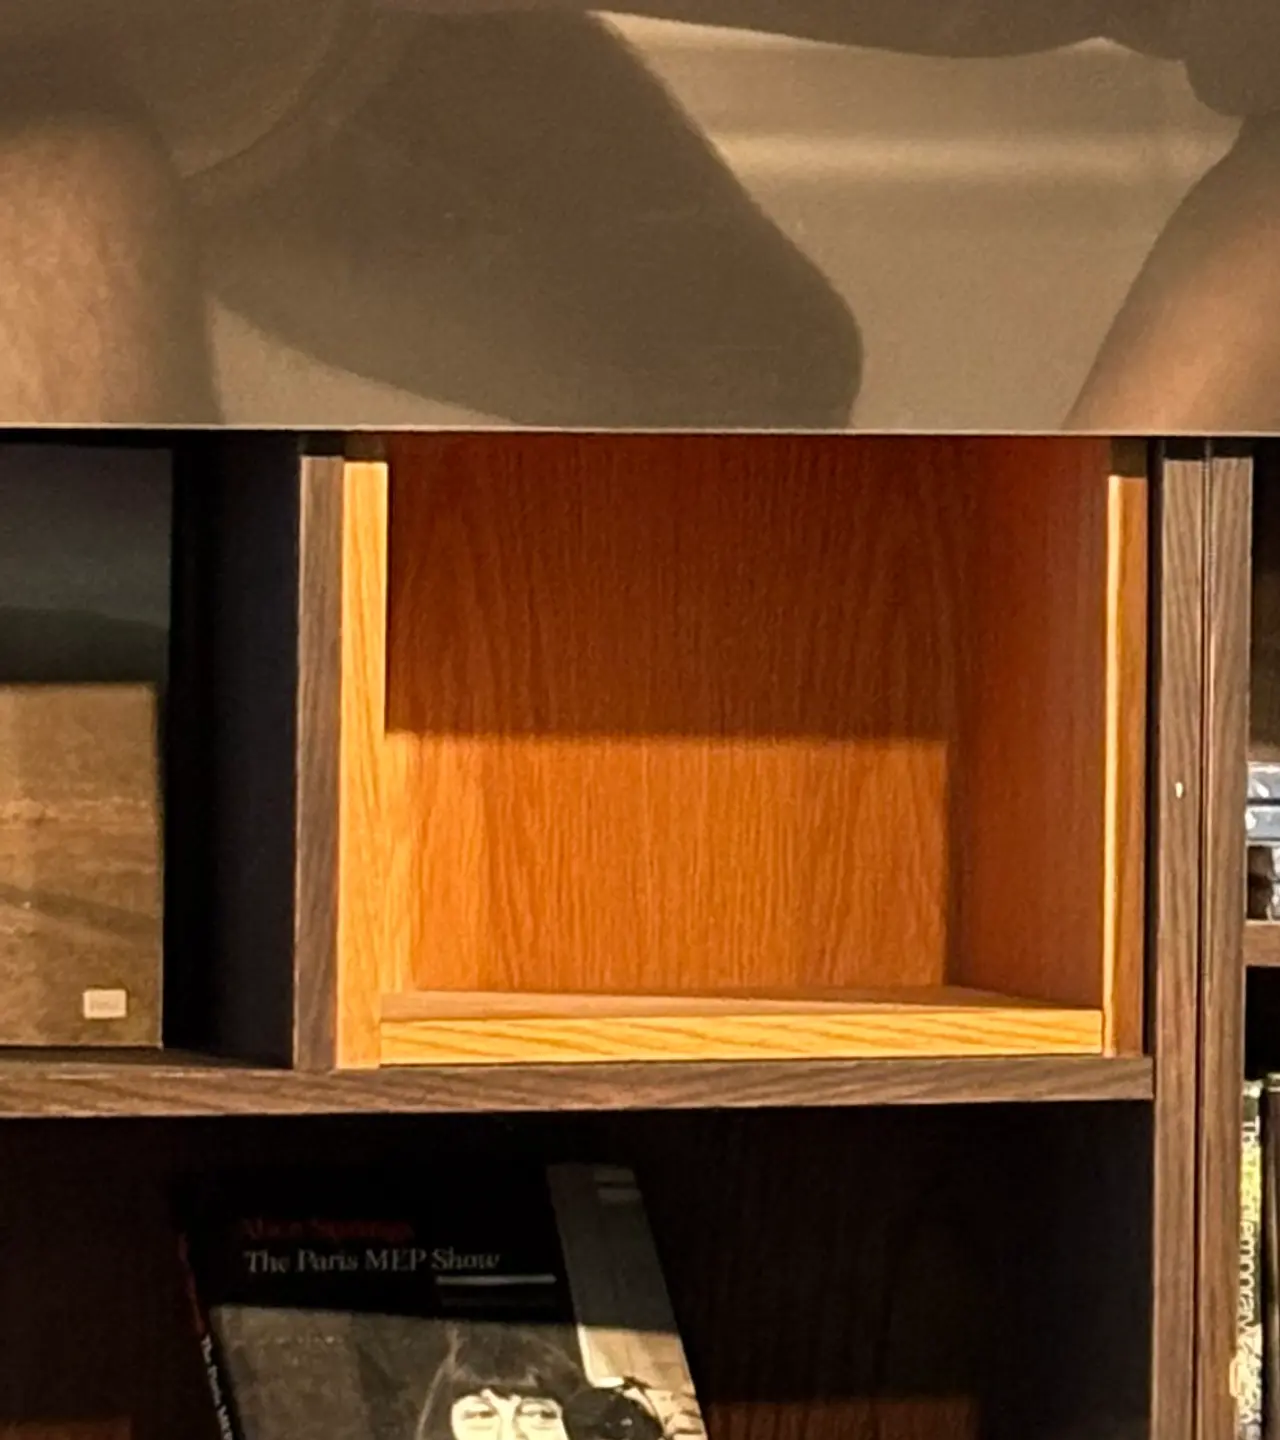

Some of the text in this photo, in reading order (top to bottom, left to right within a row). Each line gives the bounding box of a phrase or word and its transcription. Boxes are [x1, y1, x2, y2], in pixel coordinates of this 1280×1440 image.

[244, 1246, 501, 1274] The Paris MEP Show
